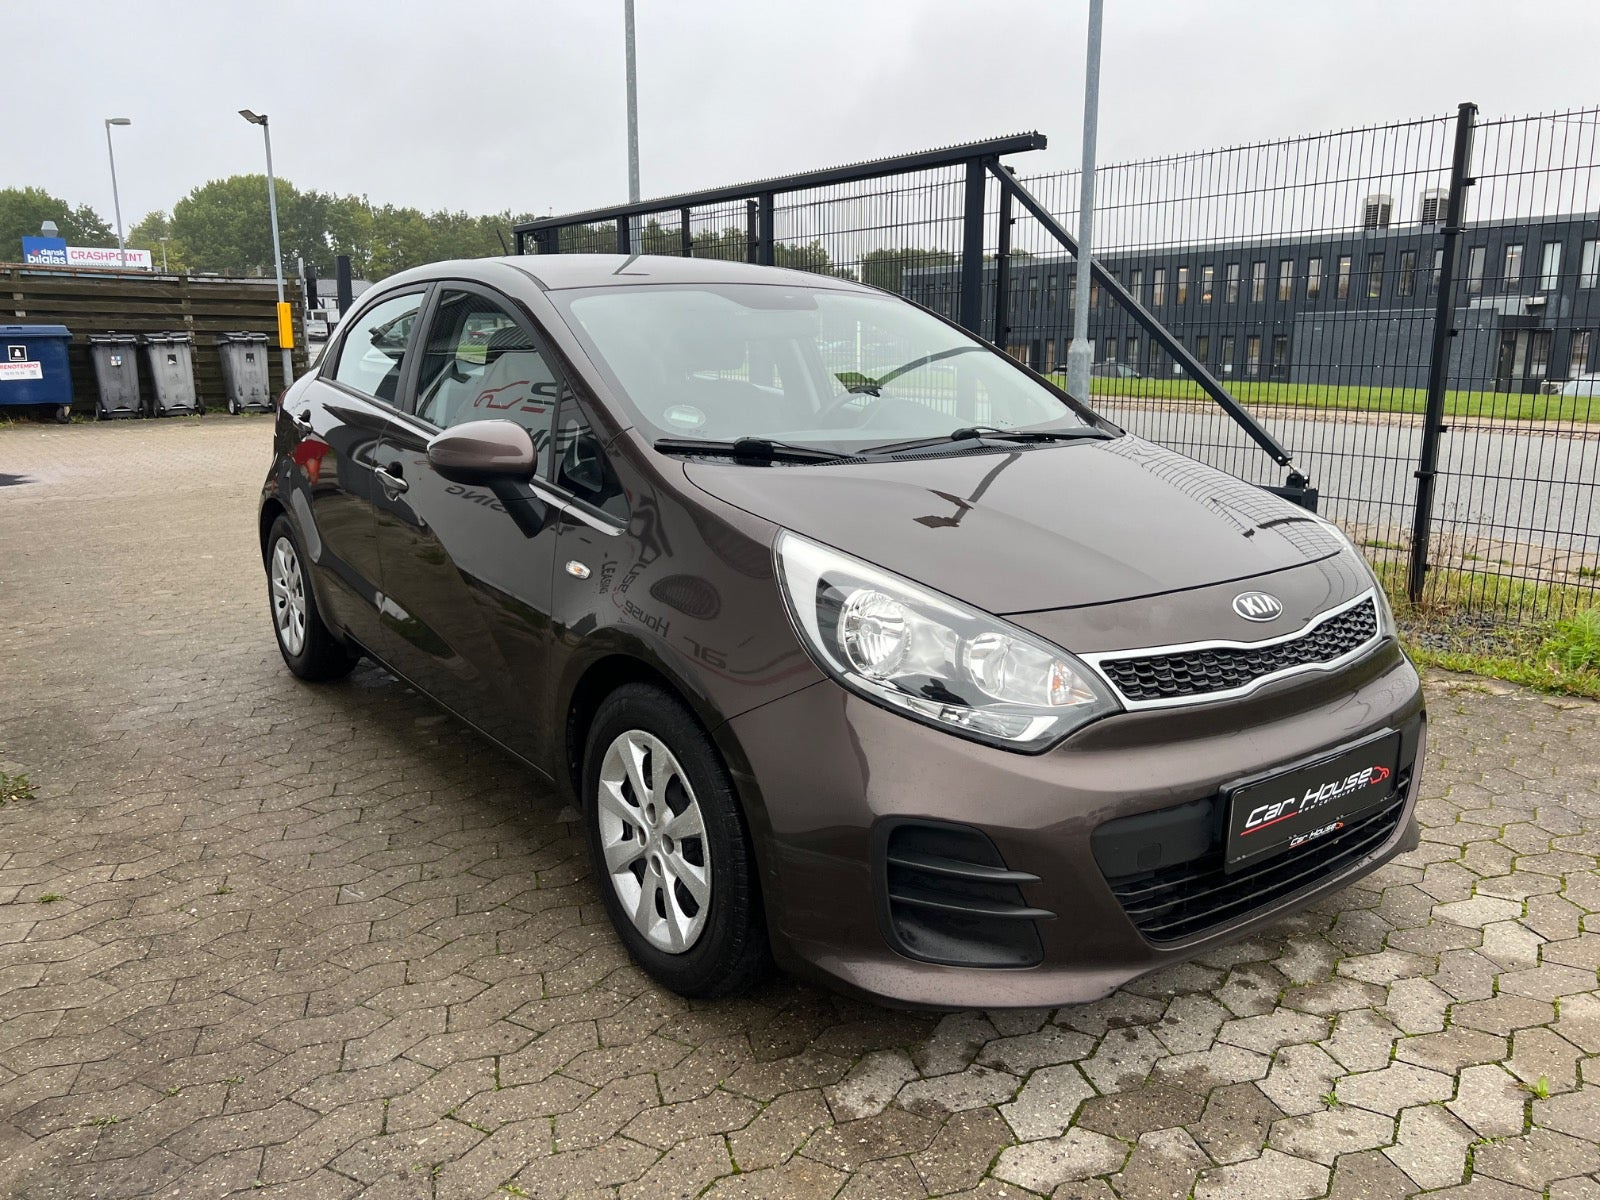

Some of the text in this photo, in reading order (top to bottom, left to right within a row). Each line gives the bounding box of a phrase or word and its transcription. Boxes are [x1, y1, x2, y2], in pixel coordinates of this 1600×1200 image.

[1239, 594, 1280, 616] KIA
[1245, 767, 1374, 828] Car House
